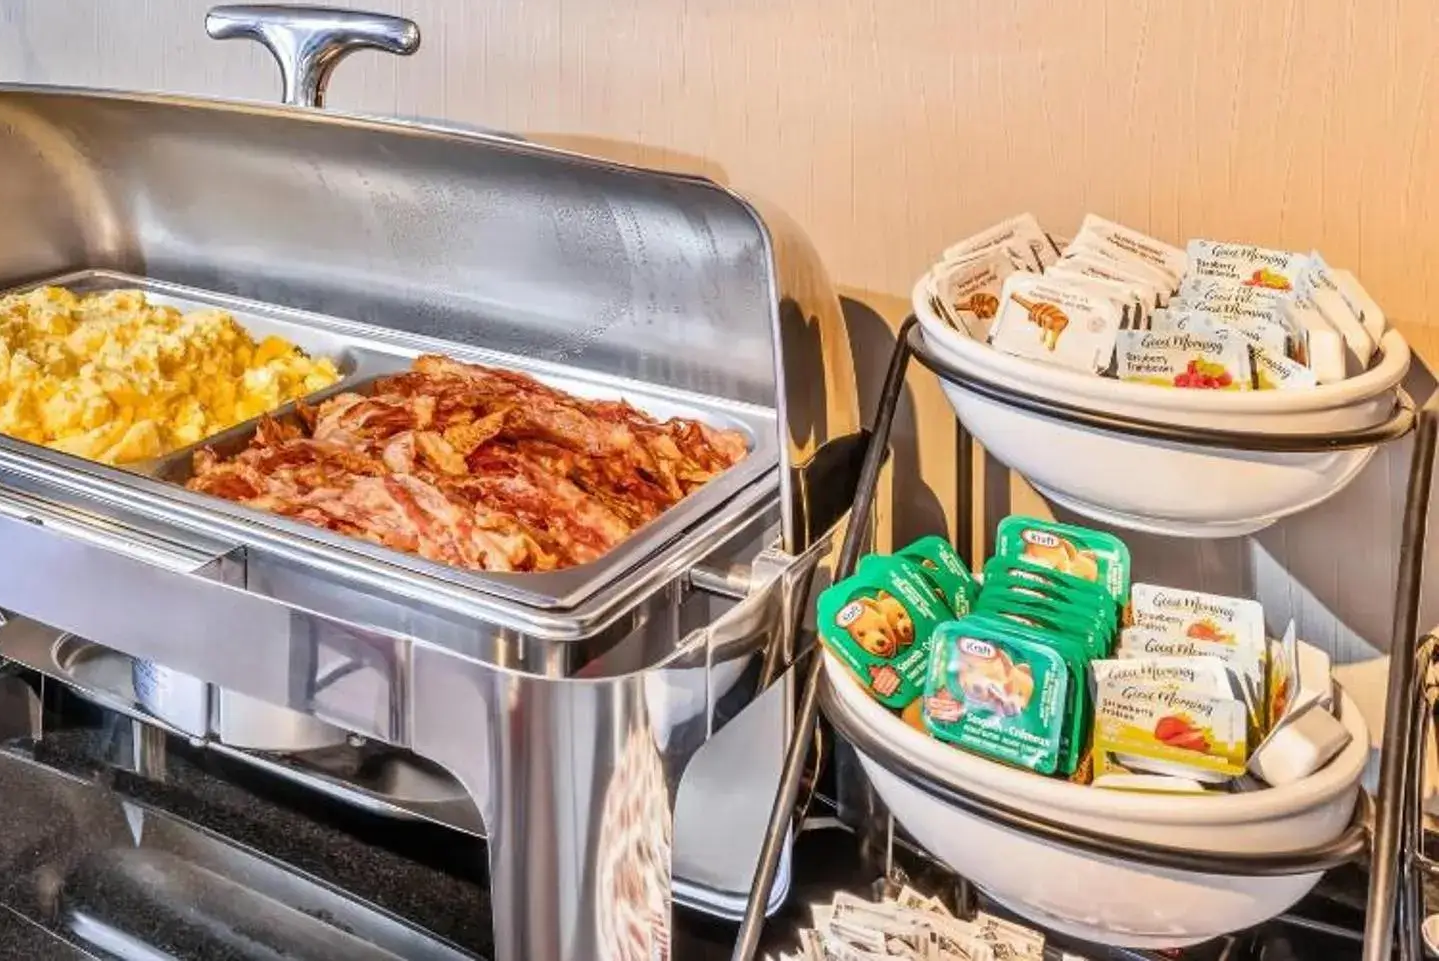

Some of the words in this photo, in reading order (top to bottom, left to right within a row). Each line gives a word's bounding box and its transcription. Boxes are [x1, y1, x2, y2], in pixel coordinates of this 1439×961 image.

[1140, 333, 1171, 349] Good
[1173, 334, 1224, 355] Morning
[966, 640, 991, 655] Kraft
[1122, 686, 1154, 700] Good
[1158, 690, 1213, 717] Morning
